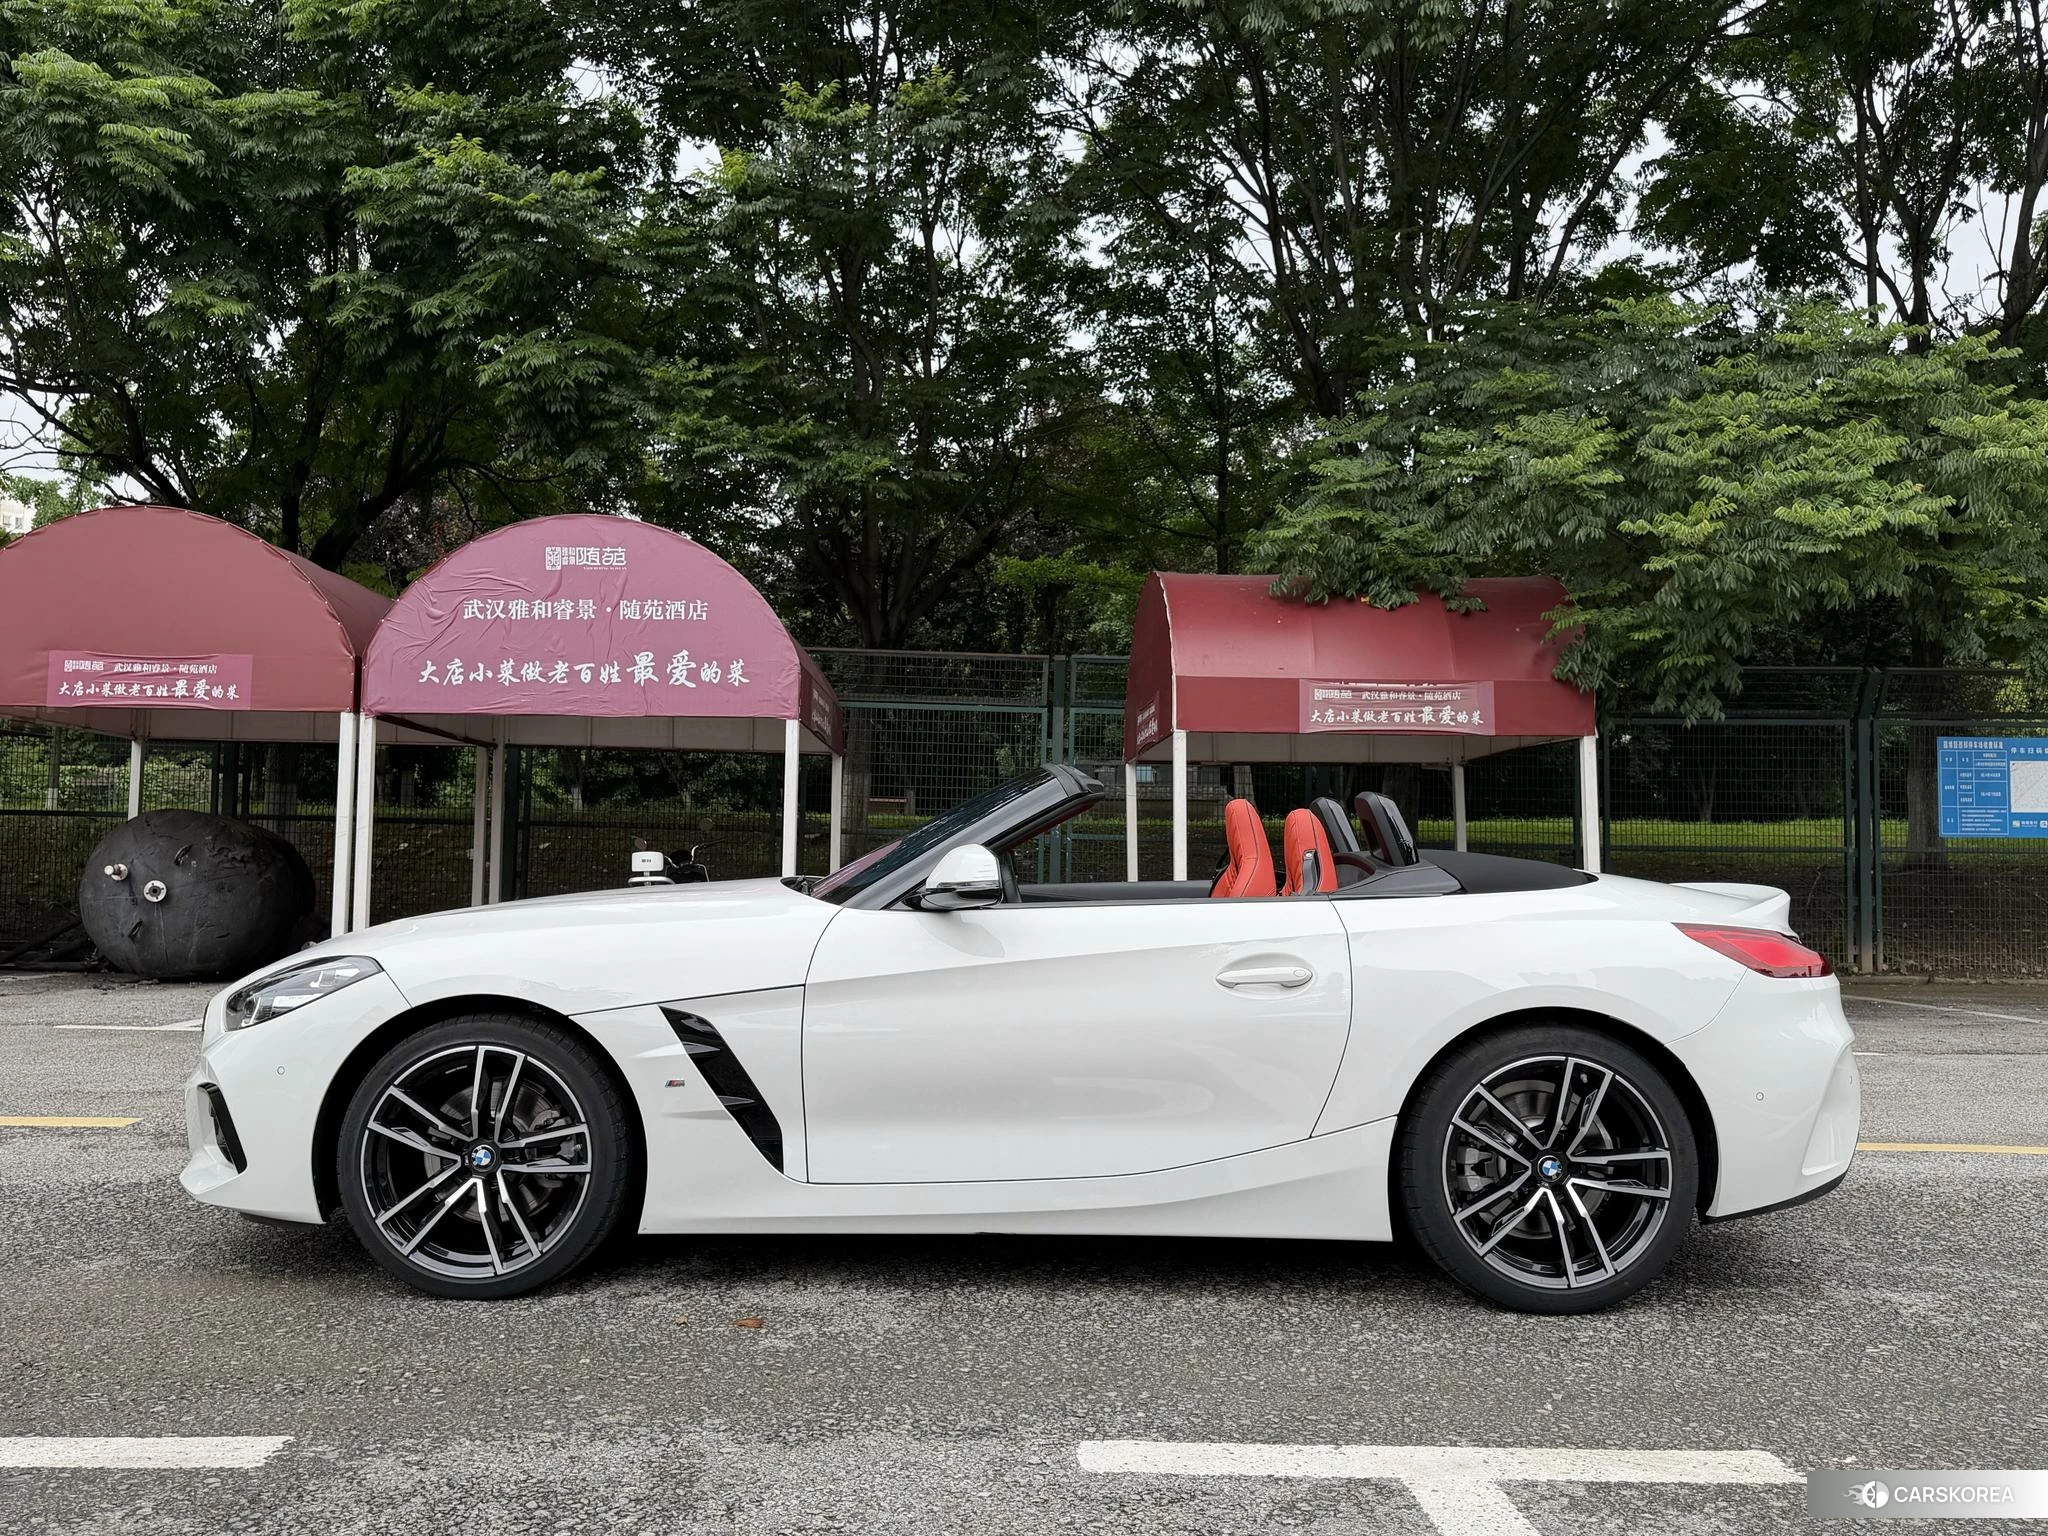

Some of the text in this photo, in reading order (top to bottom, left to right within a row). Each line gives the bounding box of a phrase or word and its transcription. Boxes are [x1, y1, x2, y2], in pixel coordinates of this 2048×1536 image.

[463, 599, 709, 620] 武汉雅和睿景·随苑酒店
[418, 650, 751, 688] 大店小菜做老百姓最爱的菜
[58, 679, 240, 700] 大店小菜做老百姓最爱的菜
[1310, 705, 1484, 726] 大店小菜做老百姓最爱的菜
